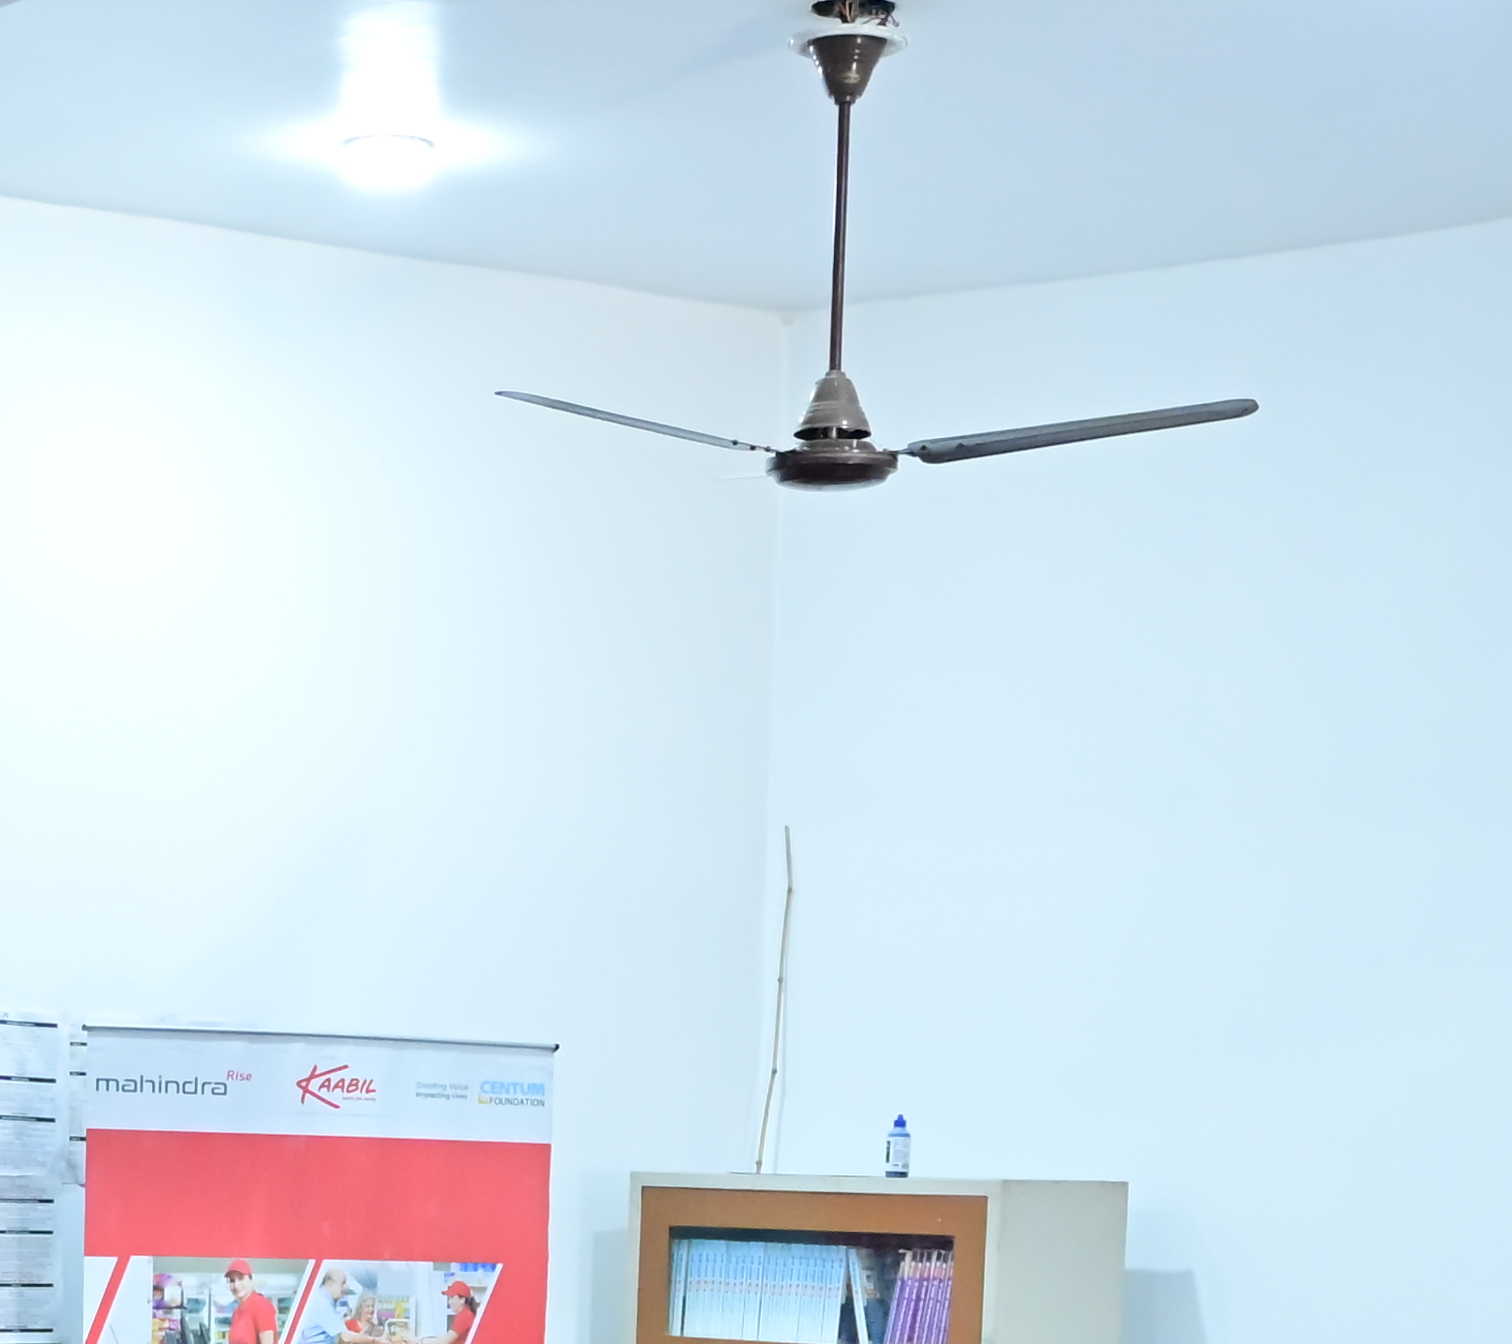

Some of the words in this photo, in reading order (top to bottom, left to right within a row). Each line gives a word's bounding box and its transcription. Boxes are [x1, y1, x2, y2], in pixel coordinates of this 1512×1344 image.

[95, 1074, 227, 1096] mahindra
[226, 1069, 253, 1082] Rise
[295, 1063, 377, 1110] KAABIL
[480, 1080, 546, 1097] CENTUM
[489, 1096, 546, 1108] FOUNDATION
